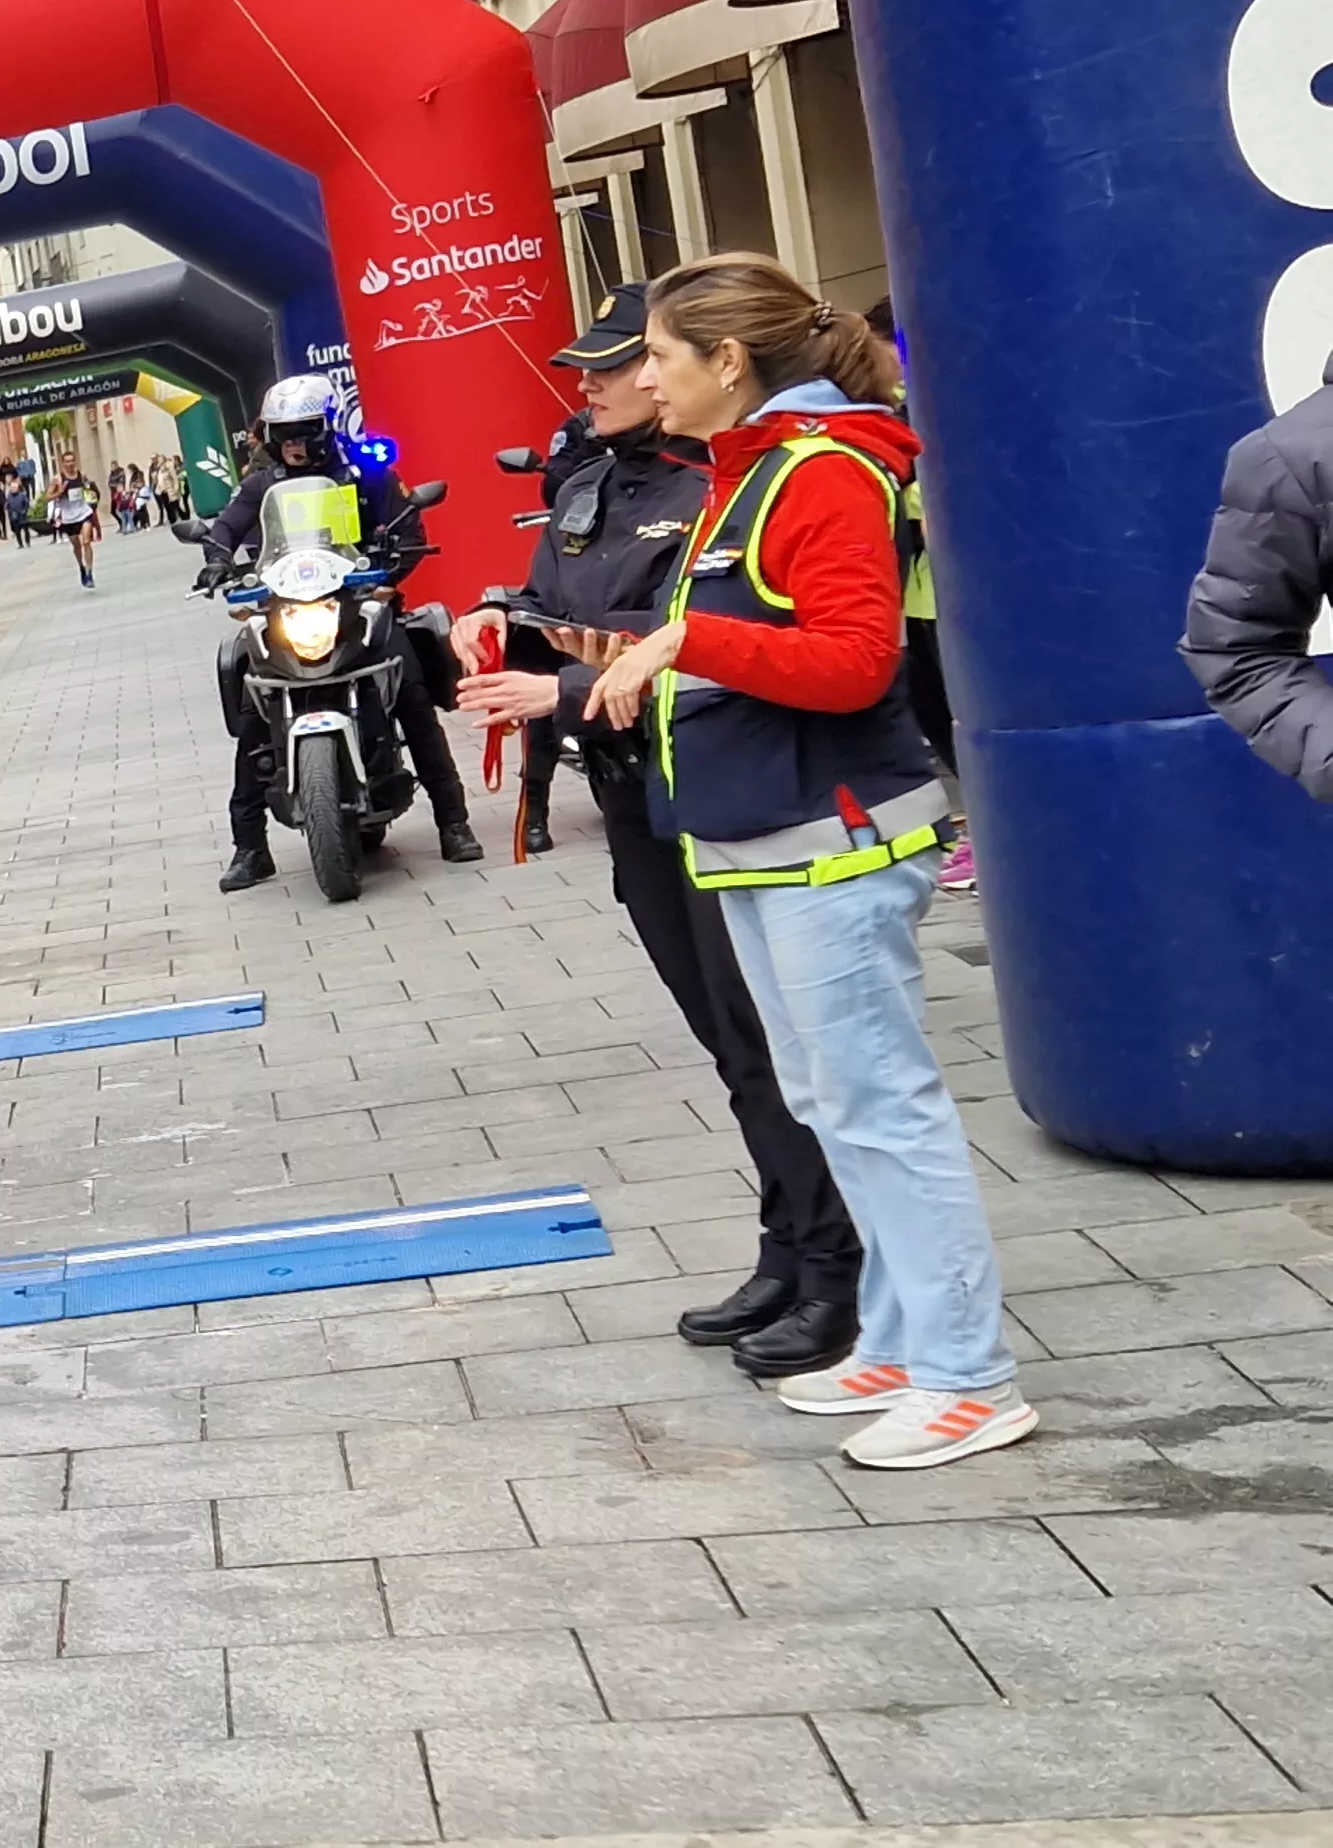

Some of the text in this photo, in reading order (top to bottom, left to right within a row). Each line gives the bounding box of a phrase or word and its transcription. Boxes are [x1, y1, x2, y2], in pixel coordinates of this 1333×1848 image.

[391, 192, 494, 236] Sports
[392, 234, 543, 286] Santander
[7, 397, 47, 411] RURAL
[50, 391, 66, 403] DE
[70, 380, 121, 399] ARAGÓN
